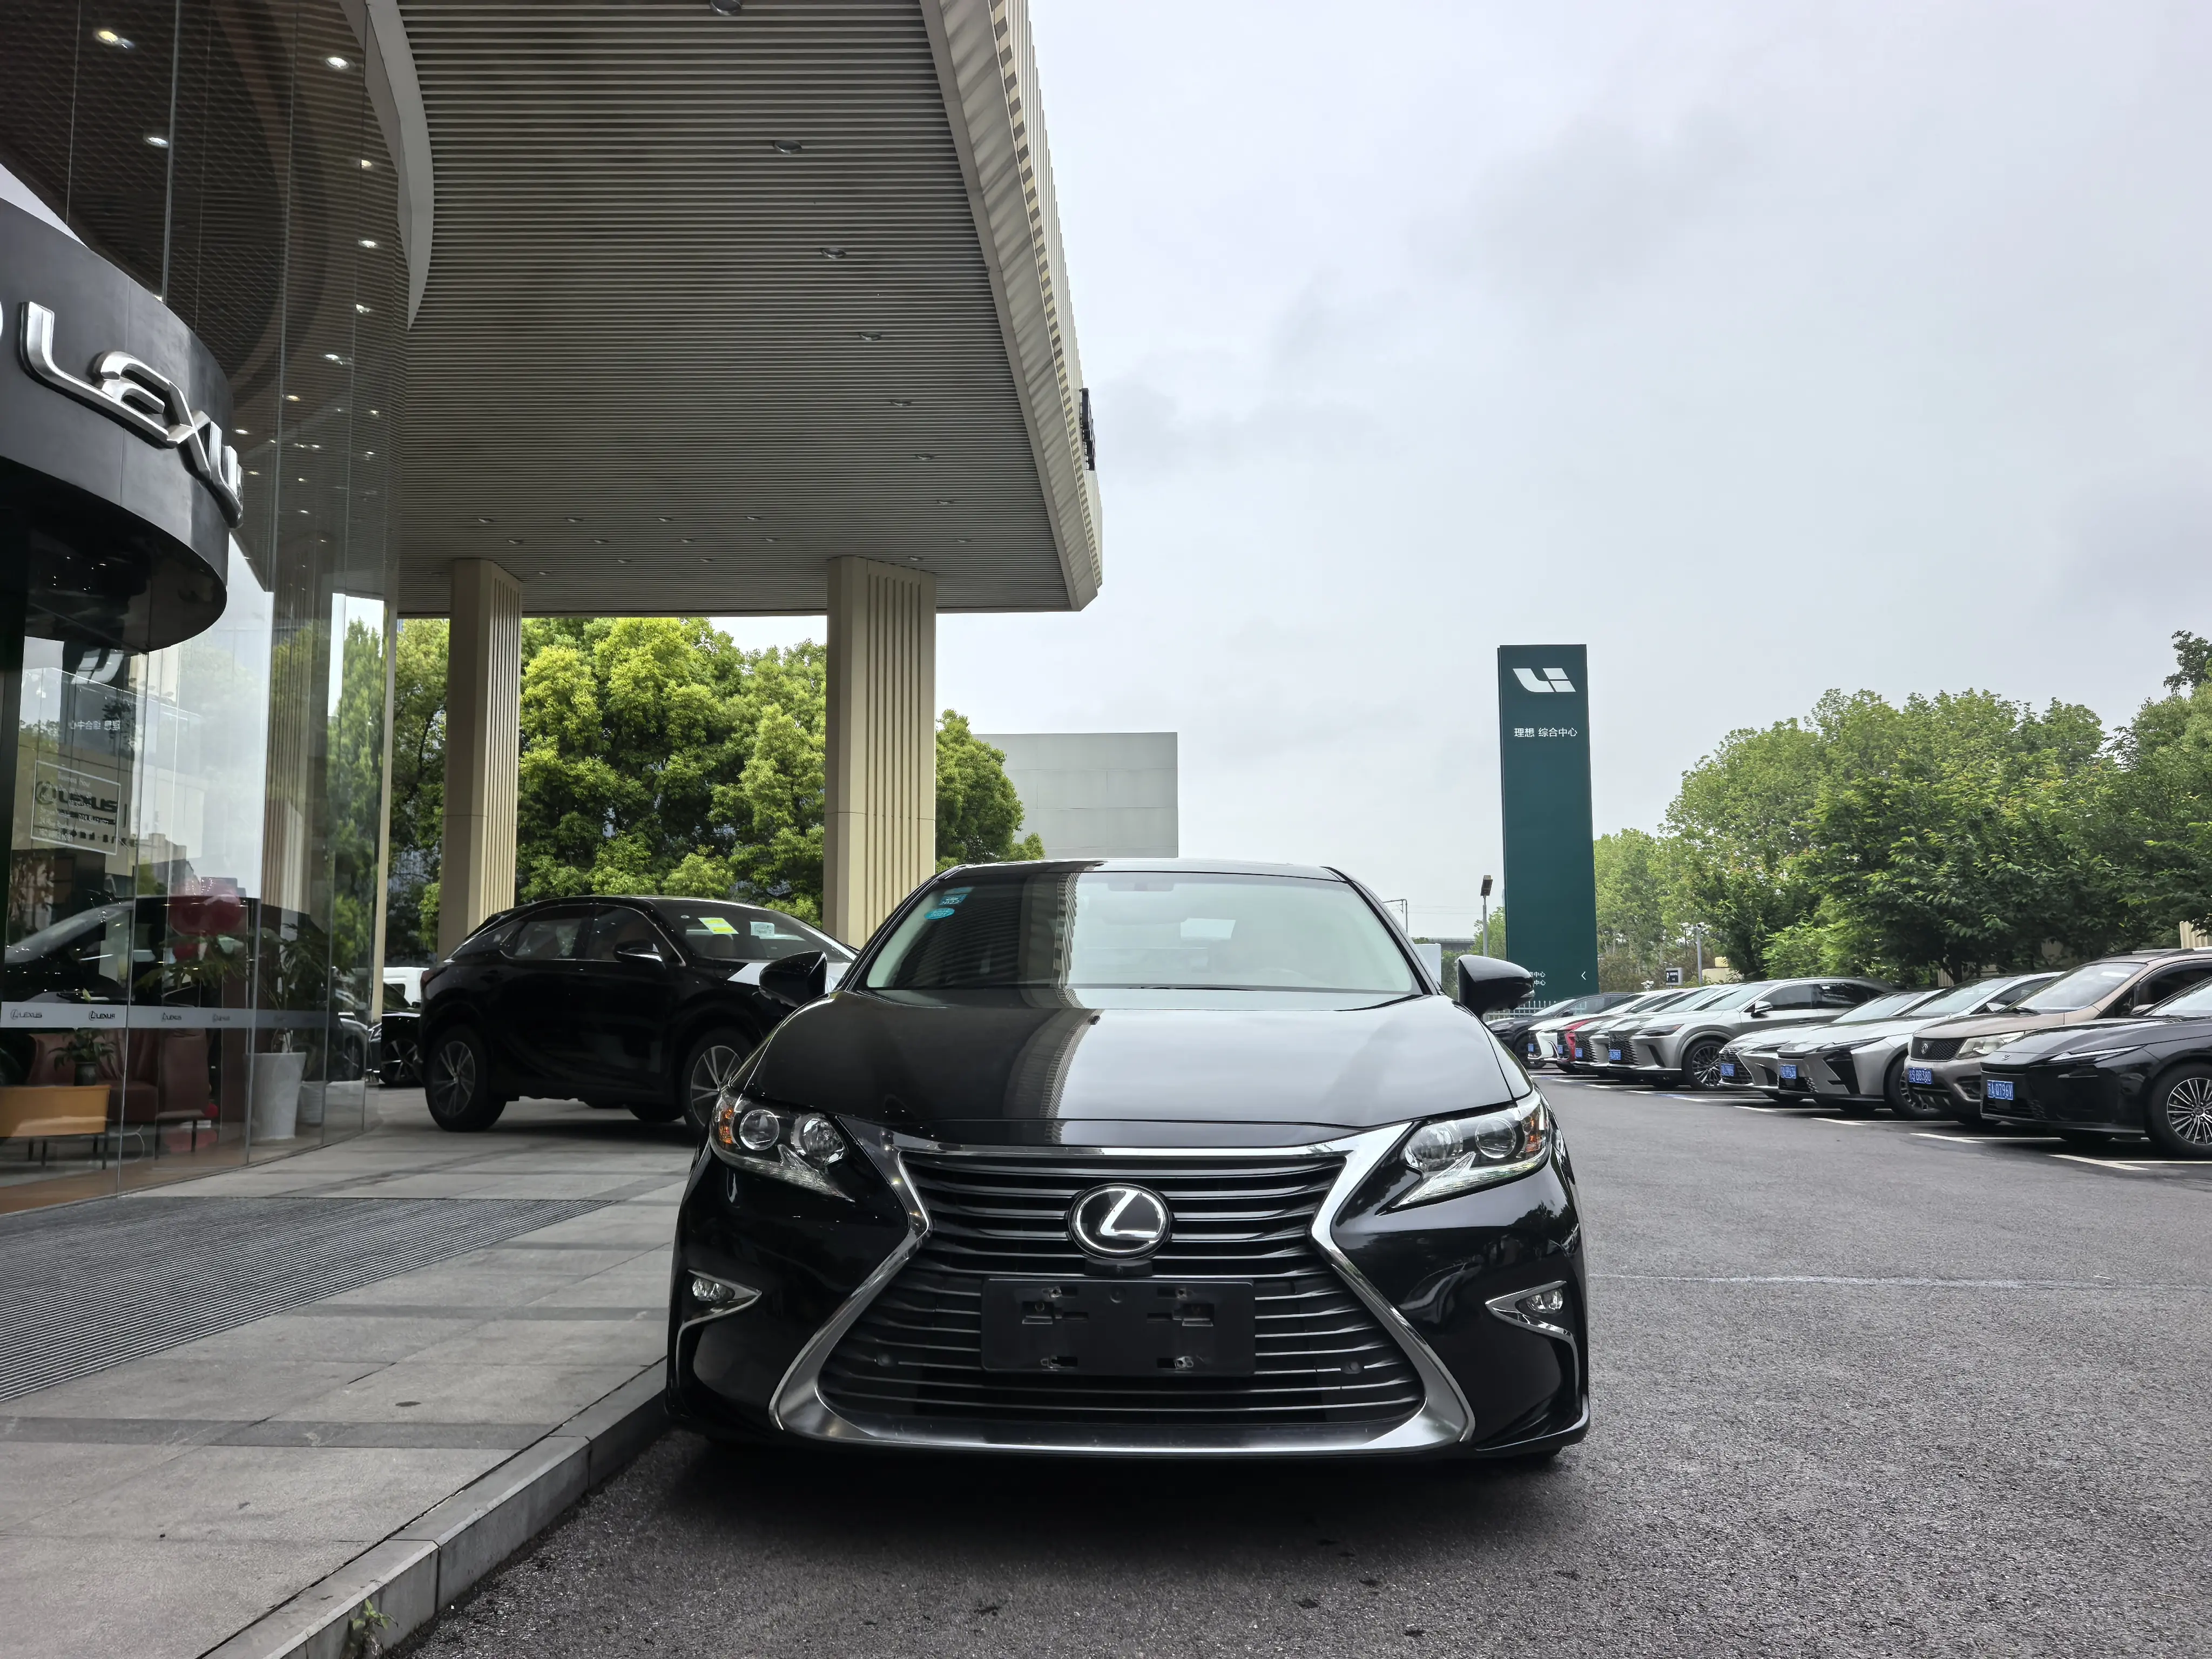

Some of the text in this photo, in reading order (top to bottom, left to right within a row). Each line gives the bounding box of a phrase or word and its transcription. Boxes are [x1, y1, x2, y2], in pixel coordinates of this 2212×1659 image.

[20, 300, 243, 528] LEXU
[1514, 727, 1577, 737] 理想 综合中心
